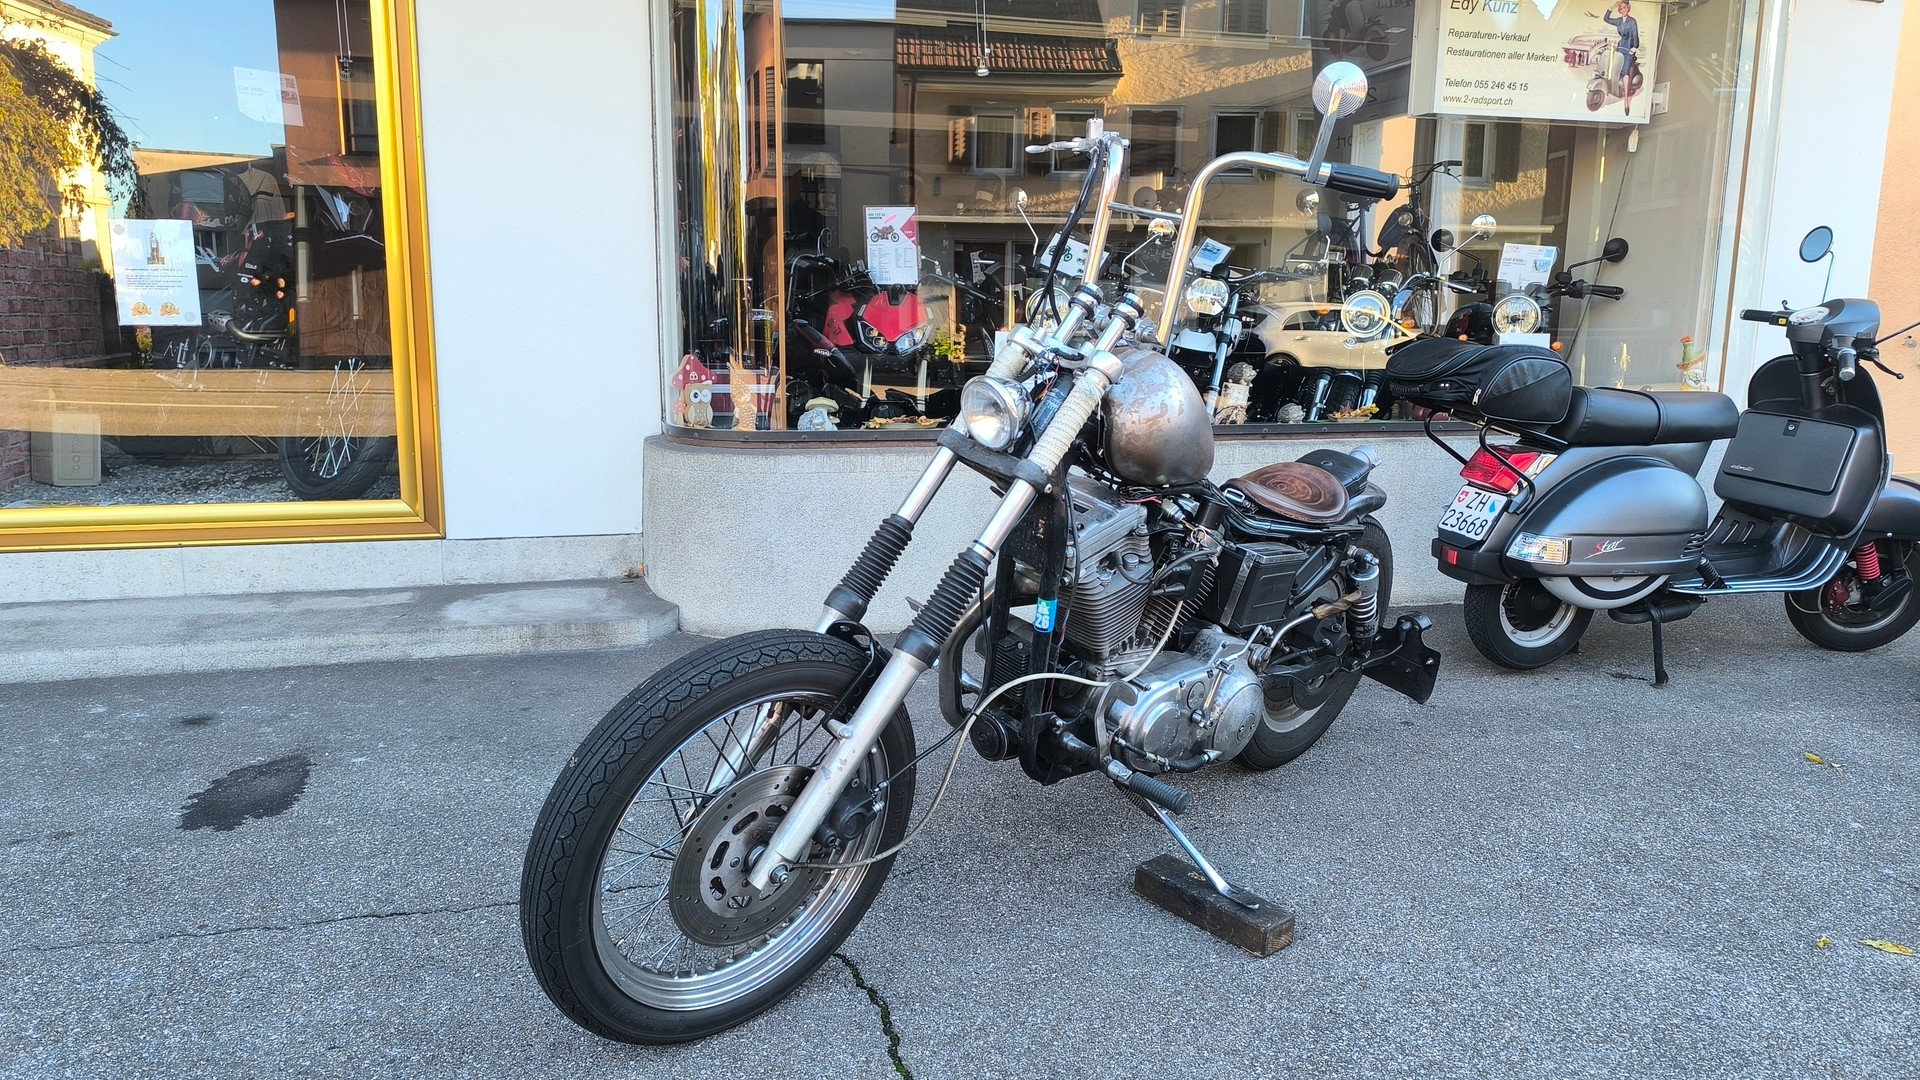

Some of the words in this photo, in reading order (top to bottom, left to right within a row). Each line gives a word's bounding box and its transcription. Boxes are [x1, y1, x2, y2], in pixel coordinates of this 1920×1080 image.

[1450, 0, 1479, 14] Edy
[1482, 0, 1519, 14] Kunz
[1448, 28, 1531, 42] Reparaturen-Verkauf
[1446, 46, 1506, 60] Restaurationen
[1508, 52, 1524, 61] aller
[1526, 54, 1559, 63] Marken!
[1444, 77, 1472, 89] Telefon
[1474, 79, 1489, 90] 055
[1490, 80, 1506, 91] 246
[1507, 82, 1517, 91] 45
[1519, 82, 1529, 92] 15
[1443, 94, 1514, 106] www.2-radsport.ch
[1465, 491, 1492, 513] ZH
[1441, 508, 1489, 536] 23668
